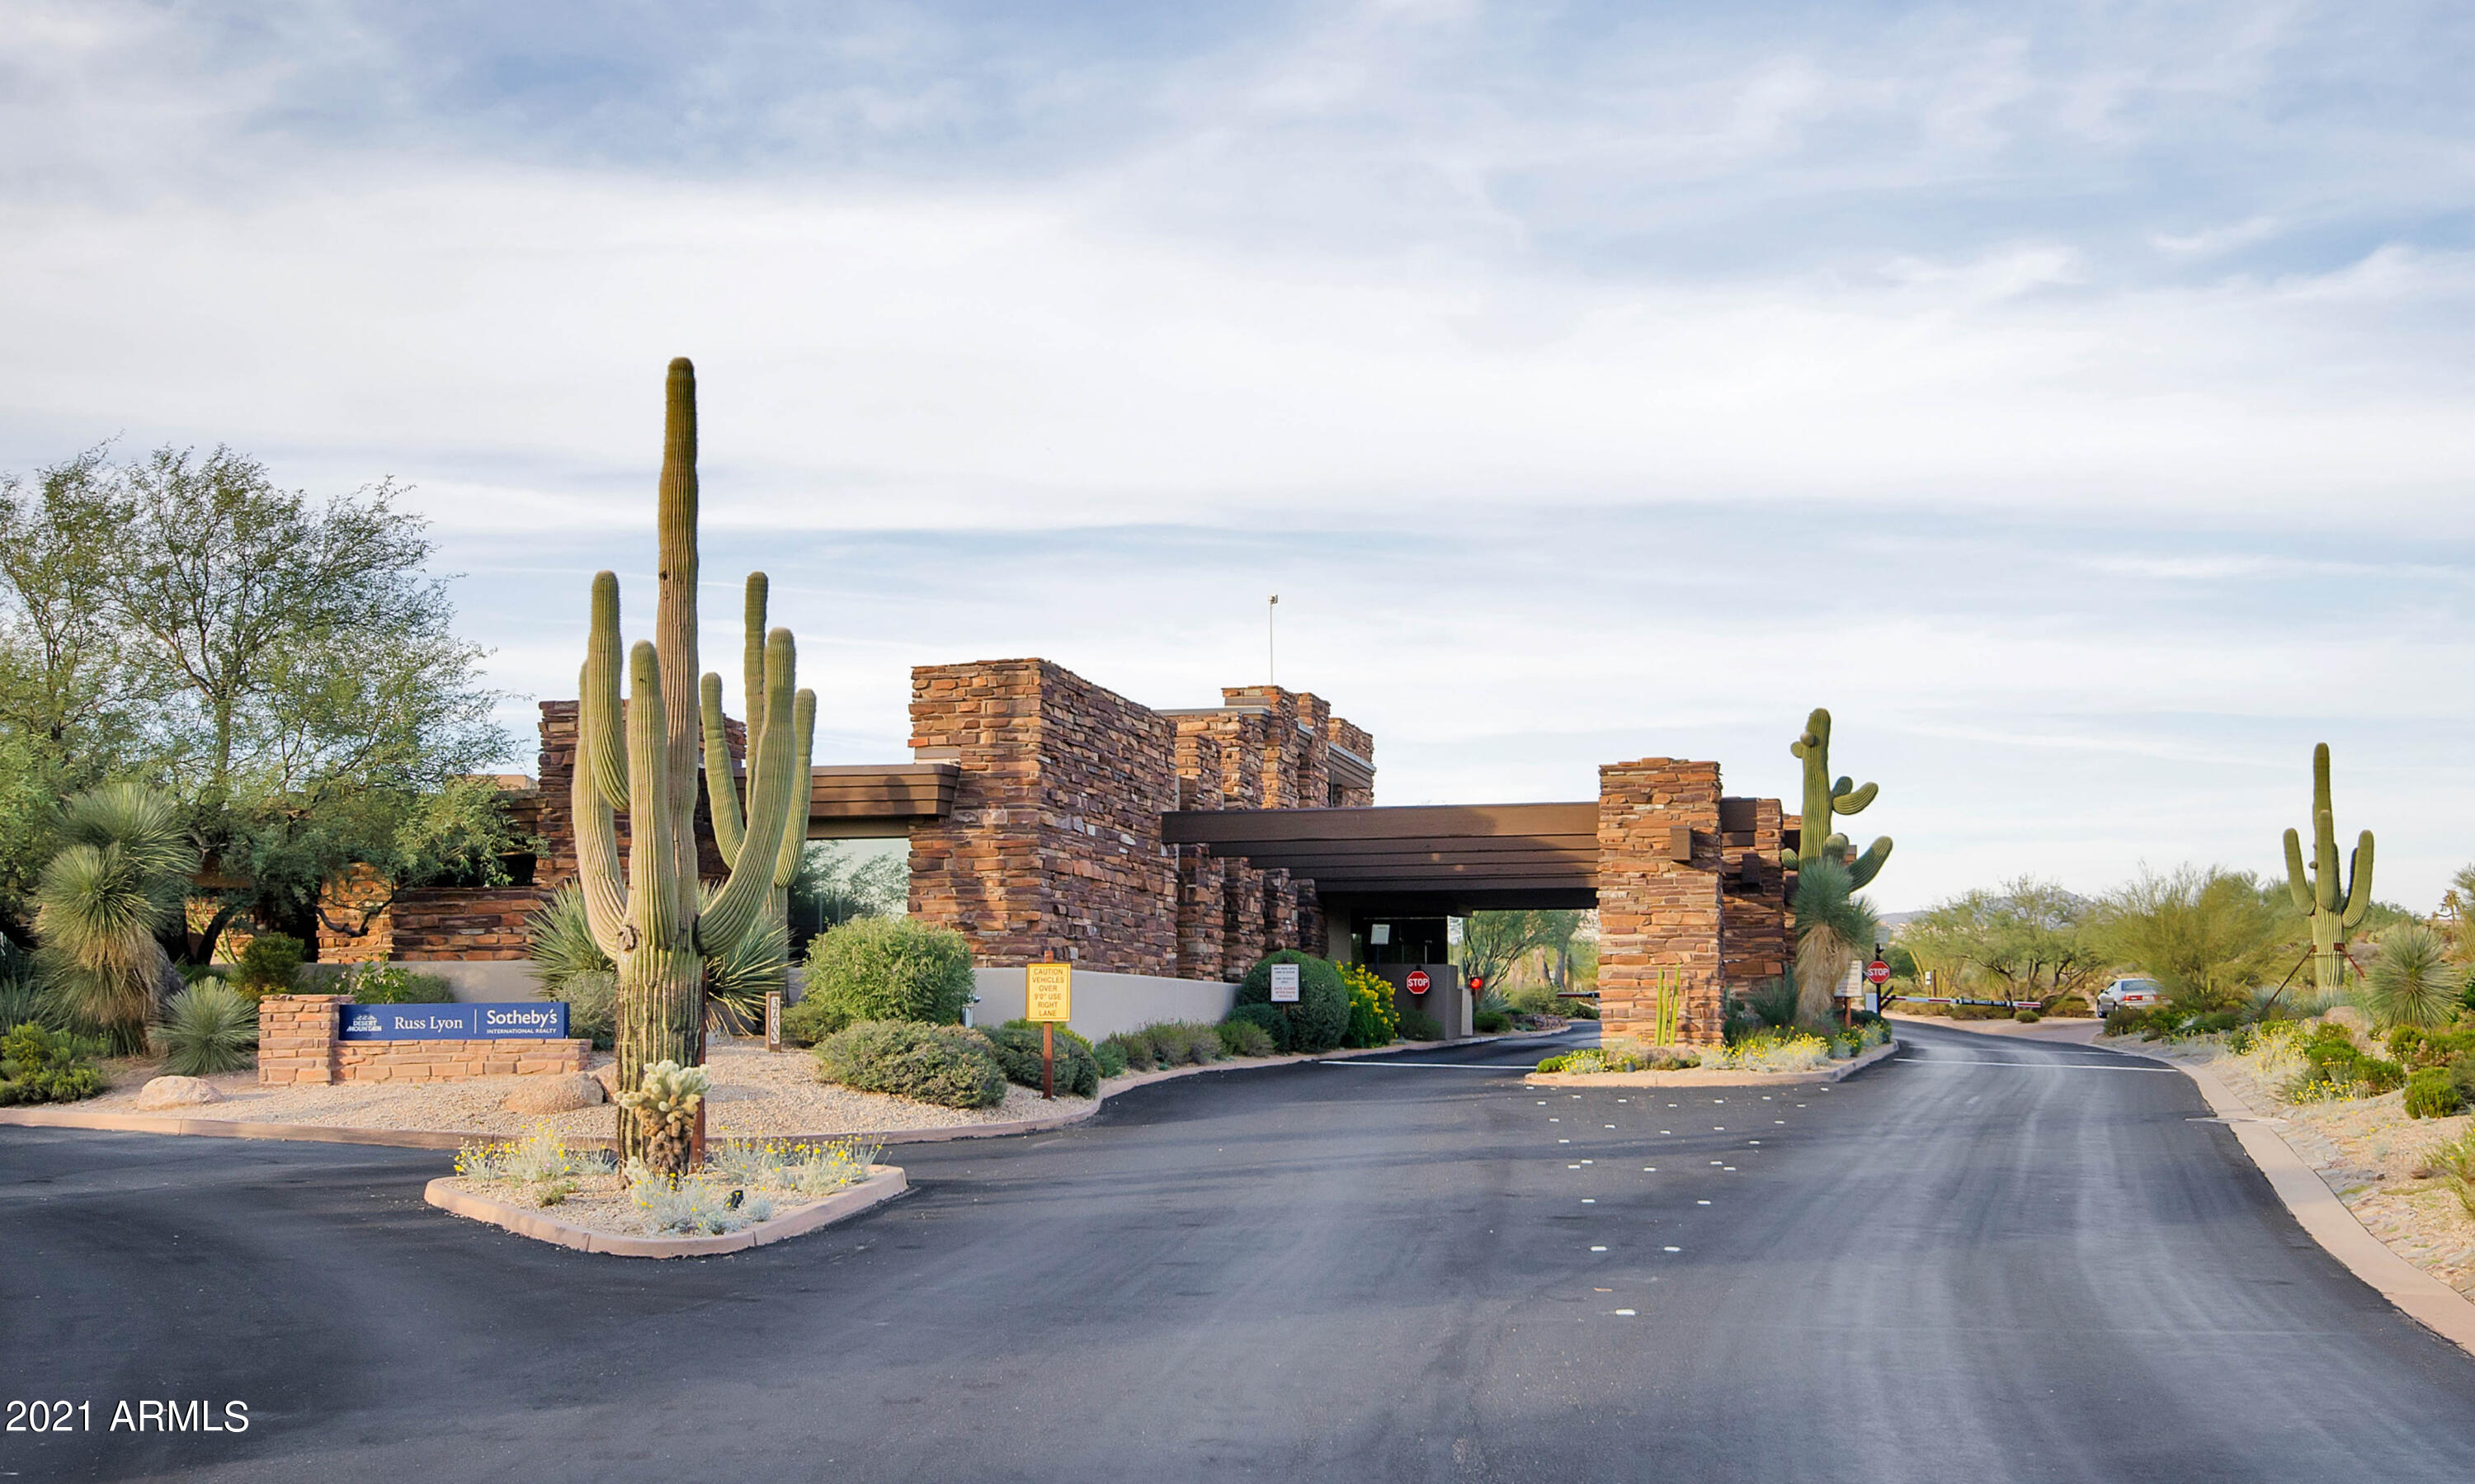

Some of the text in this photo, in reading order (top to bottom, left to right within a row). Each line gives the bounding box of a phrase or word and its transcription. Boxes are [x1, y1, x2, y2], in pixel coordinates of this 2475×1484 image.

[1868, 968, 1888, 977] STOP
[1408, 978, 1428, 987] STOP
[394, 1015, 464, 1033] Russ Lyon
[487, 1008, 558, 1029] Sotheby's
